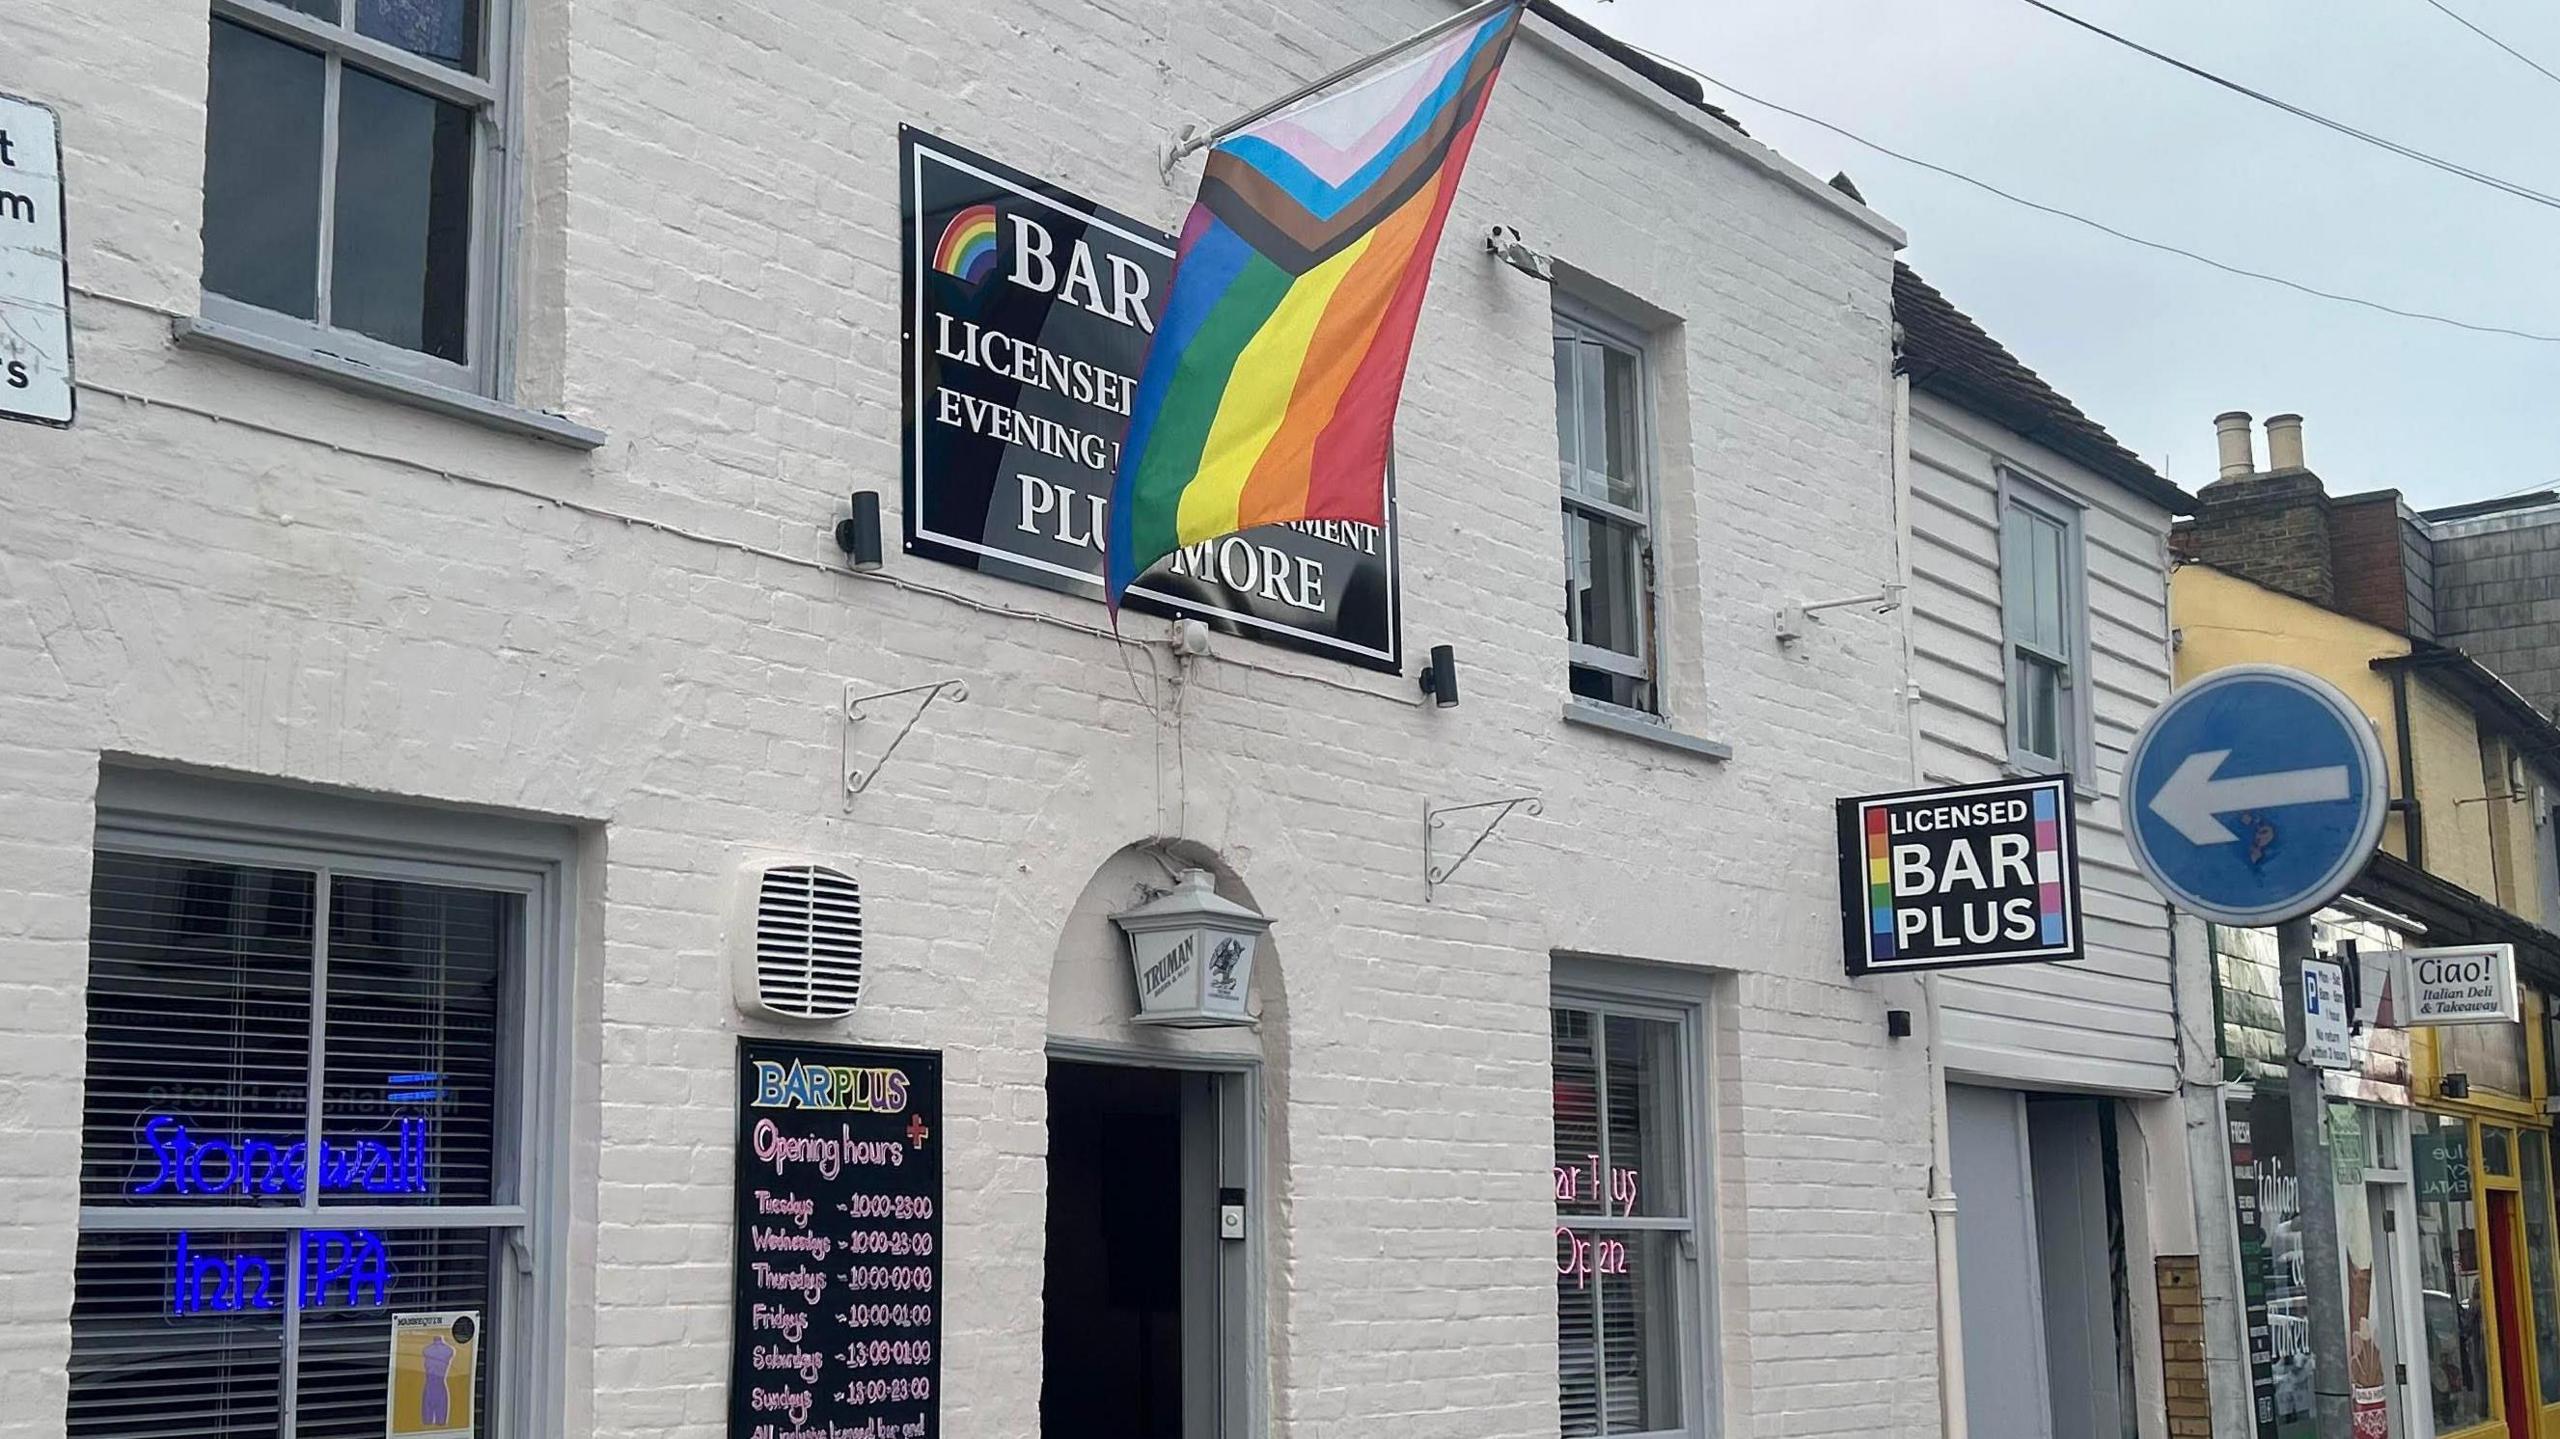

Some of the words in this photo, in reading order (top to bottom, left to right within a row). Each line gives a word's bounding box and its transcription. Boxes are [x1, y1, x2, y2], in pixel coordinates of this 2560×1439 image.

[1007, 212, 1155, 334] BAR
[936, 386, 1107, 470] EVENING
[1170, 536, 1327, 613] MORE
[1890, 800, 2028, 835] LICENSED
[1893, 833, 2035, 897] BAR
[1897, 898, 2036, 949] PLUS
[1144, 934, 1194, 995] TRUMAN
[2420, 956, 2490, 985] Ciao!
[2307, 976, 2316, 1010] P
[2420, 1002, 2432, 1014] &
[2435, 1001, 2498, 1013] Takeaway
[2423, 988, 2464, 1001] Italian
[2467, 986, 2493, 998] Deli
[132, 1115, 428, 1194] Stonewall
[753, 1117, 840, 1181] Opening
[842, 1122, 903, 1166] hours
[754, 1190, 814, 1229] Tuesdays
[751, 1225, 831, 1261] Wednesdays
[172, 1229, 275, 1317] Inn
[299, 1229, 394, 1309] IPA
[751, 1262, 827, 1305] Thursdays
[752, 1303, 809, 1343] Fridays
[752, 1344, 823, 1384] Saturdays
[752, 1384, 812, 1425] Sundays
[751, 1424, 774, 1439] All
[877, 1417, 900, 1438] bar
[902, 1412, 925, 1438] and
